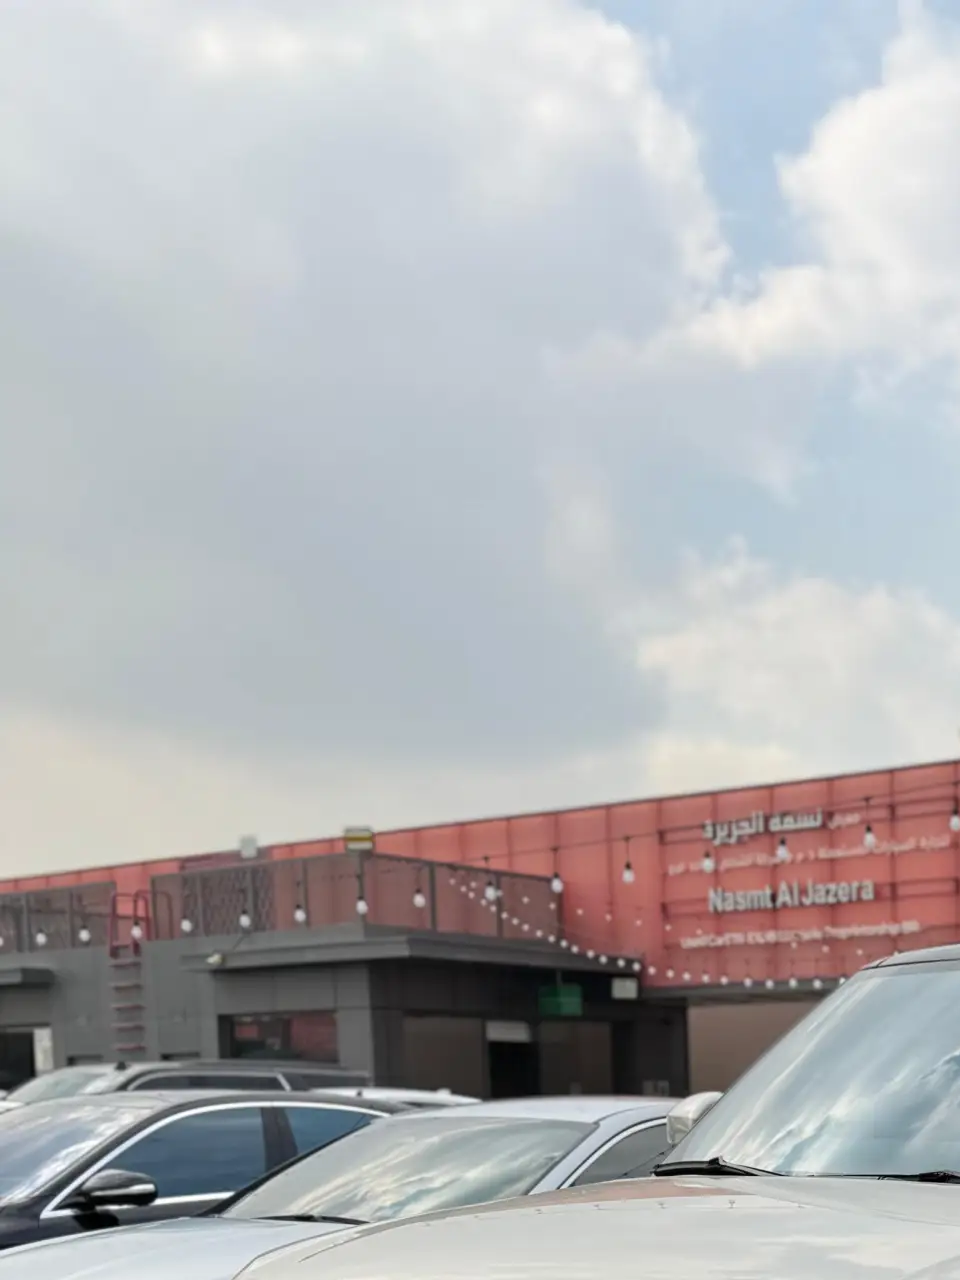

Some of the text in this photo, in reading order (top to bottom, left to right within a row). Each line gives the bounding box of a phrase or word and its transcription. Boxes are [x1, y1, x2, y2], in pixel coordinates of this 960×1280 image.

[708, 878, 875, 913] Nasmt Al Jazera
